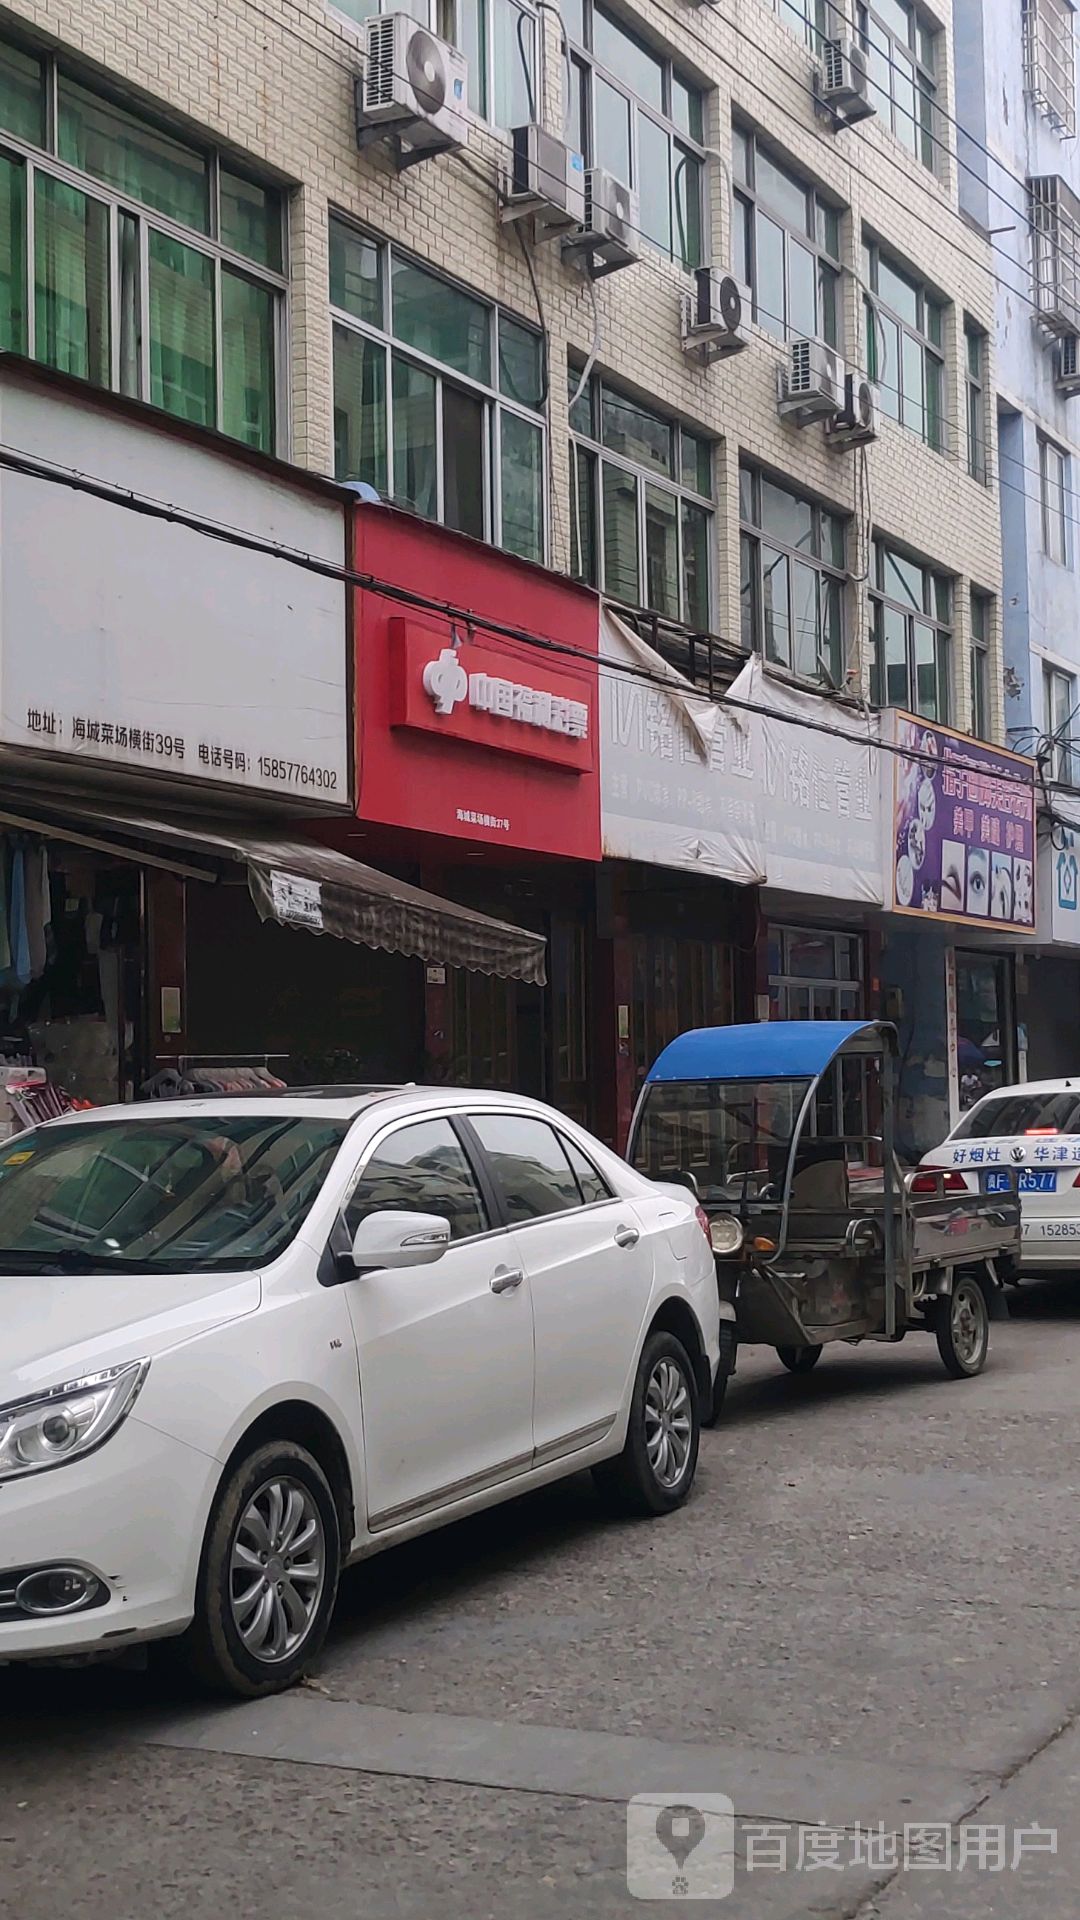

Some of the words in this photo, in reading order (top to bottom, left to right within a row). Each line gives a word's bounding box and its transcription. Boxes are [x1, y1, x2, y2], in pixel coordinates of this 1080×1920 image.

[954, 805, 974, 839] 美甲
[952, 1147, 1001, 1164] 好烟灶
